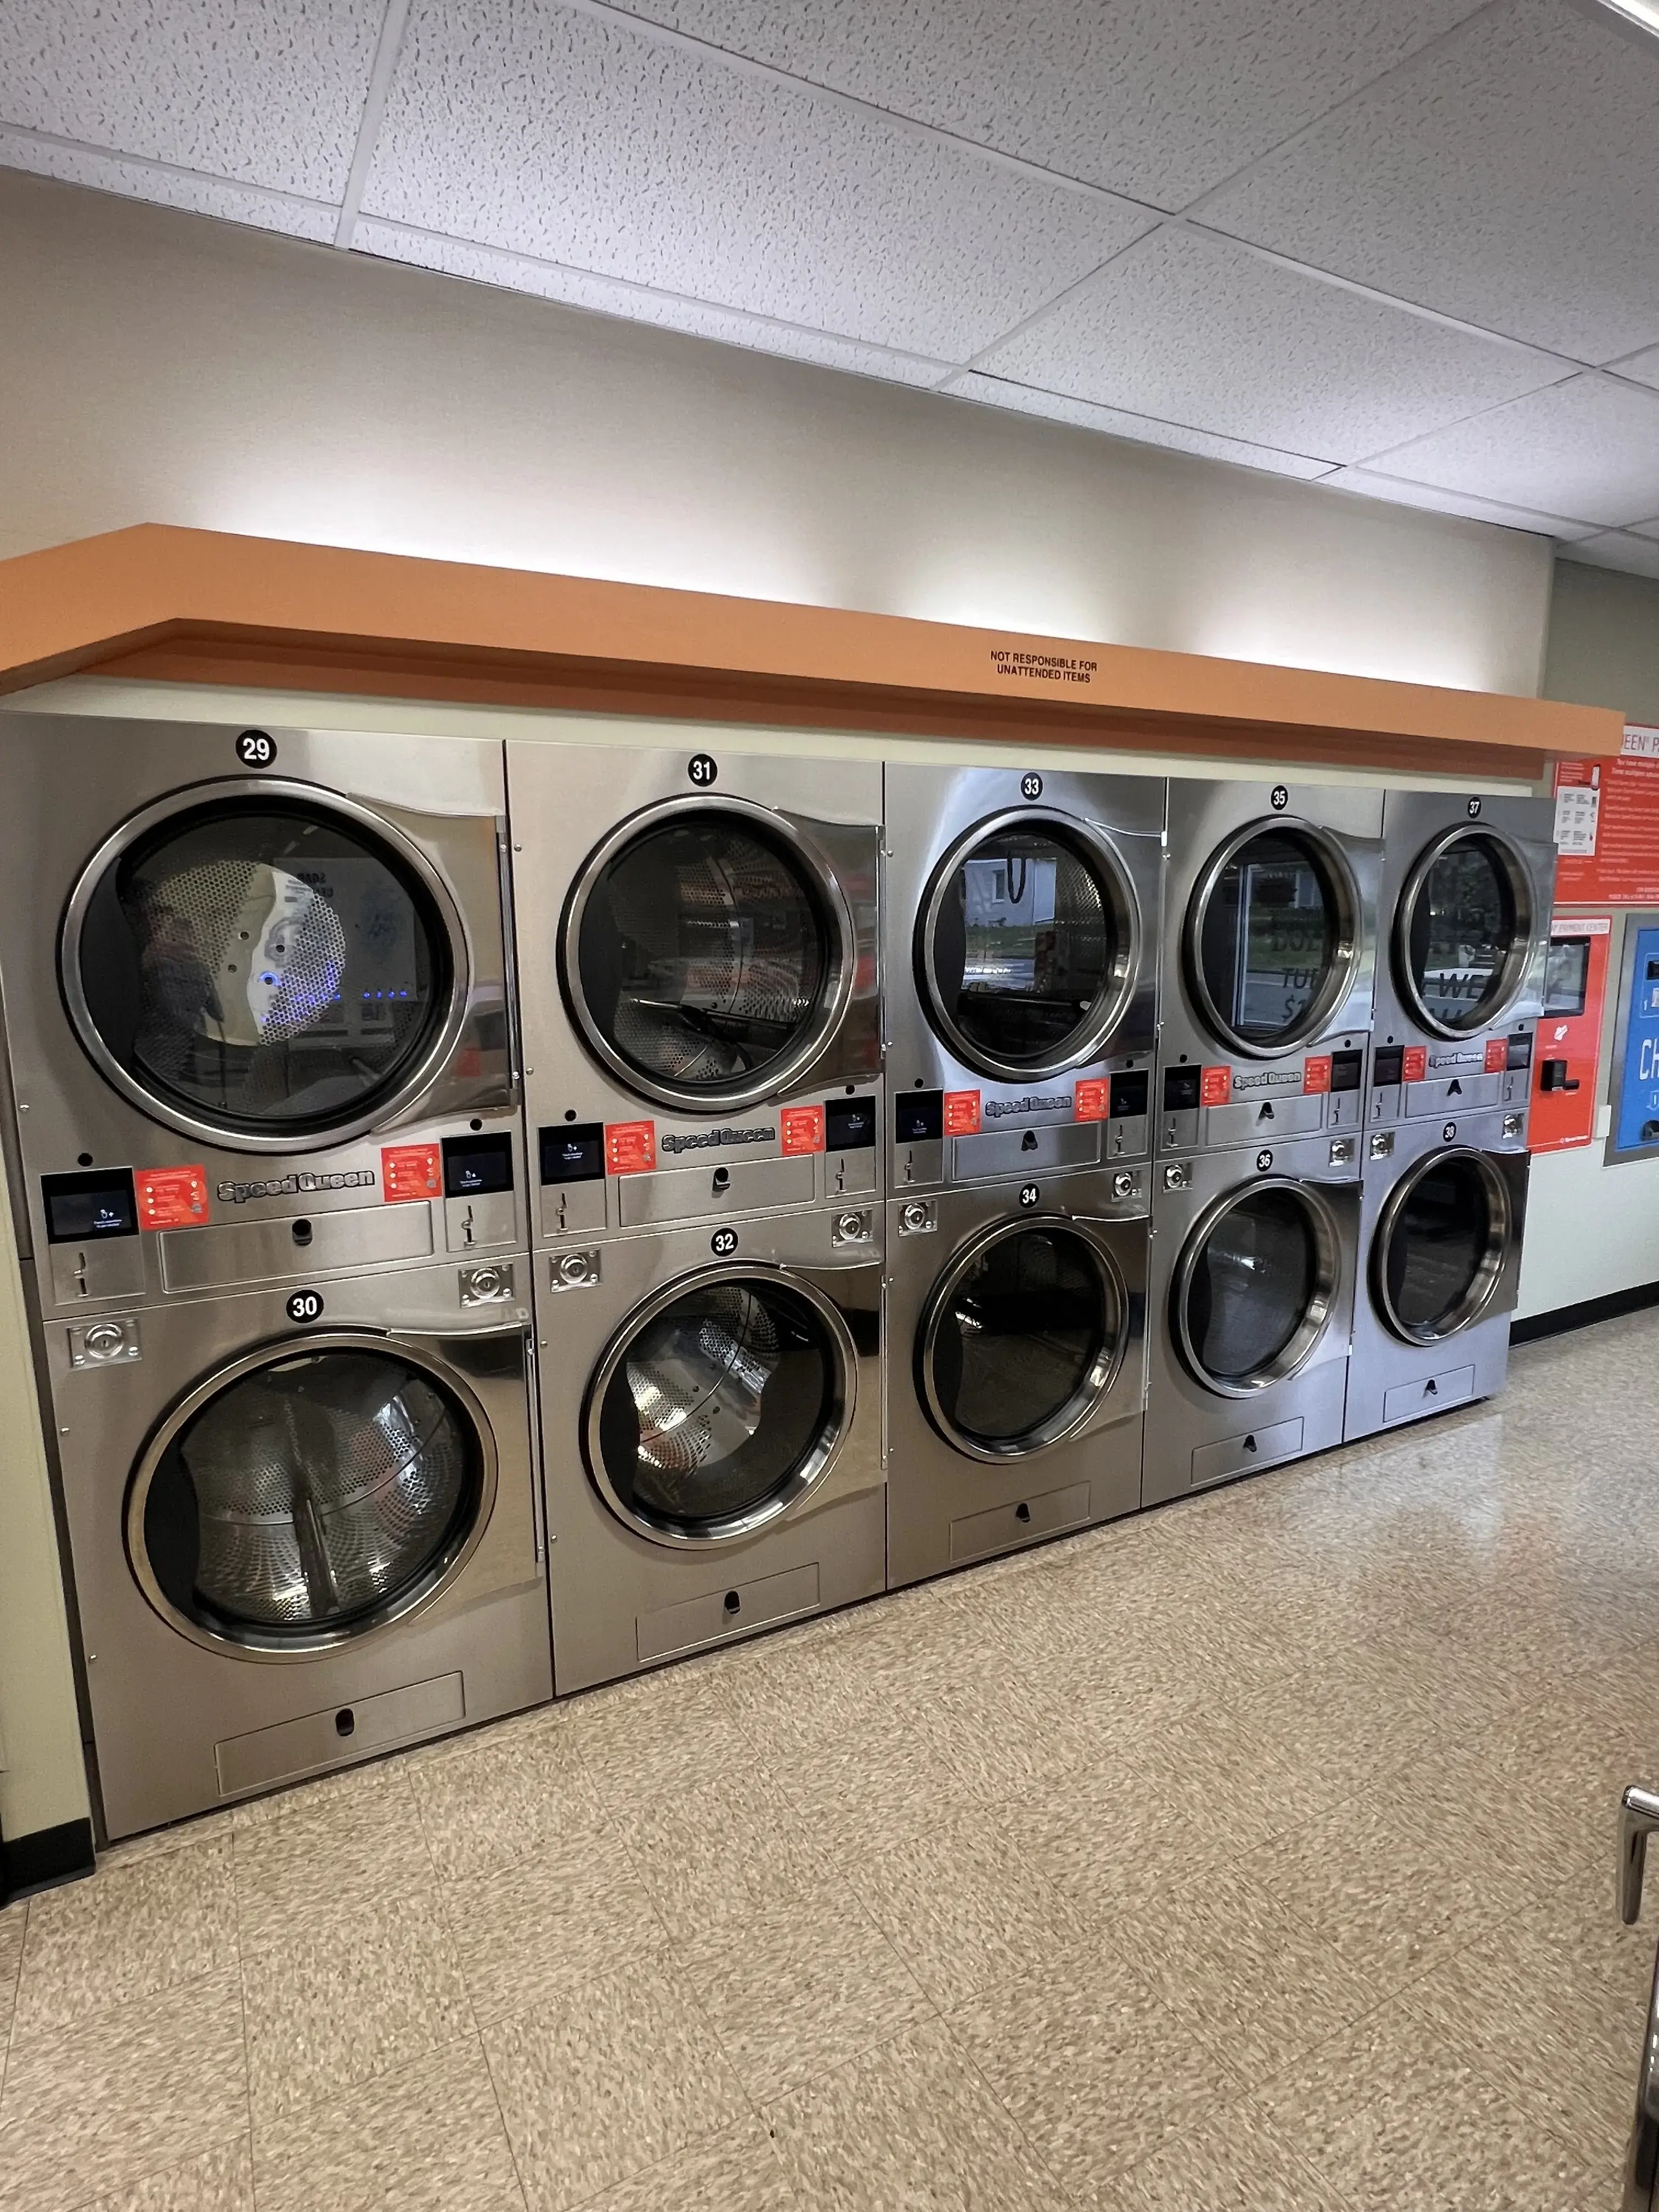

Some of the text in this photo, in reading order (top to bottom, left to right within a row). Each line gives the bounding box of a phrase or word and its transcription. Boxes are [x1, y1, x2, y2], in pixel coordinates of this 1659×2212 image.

[990, 650, 1097, 672] NOT RESPONSIBLE FOR
[997, 664, 1091, 683] UNATTENDED ITEMS
[243, 737, 270, 760] 29
[693, 760, 710, 780] 31
[1025, 778, 1039, 794] 33
[1273, 791, 1285, 805] 35
[1469, 801, 1480, 814] 37
[1233, 1071, 1268, 1091] Speed
[1268, 1071, 1301, 1085] Queen
[985, 1097, 1030, 1118] Speed
[1030, 1096, 1072, 1111] Queen
[662, 1129, 720, 1154] Speed
[720, 1127, 776, 1145] Queen
[1259, 1154, 1271, 1167] 36
[217, 1174, 299, 1204] Speed
[298, 1170, 375, 1192] Queen
[1023, 1188, 1037, 1204] 34
[715, 1233, 734, 1251] 32
[292, 1296, 317, 1317] 30
